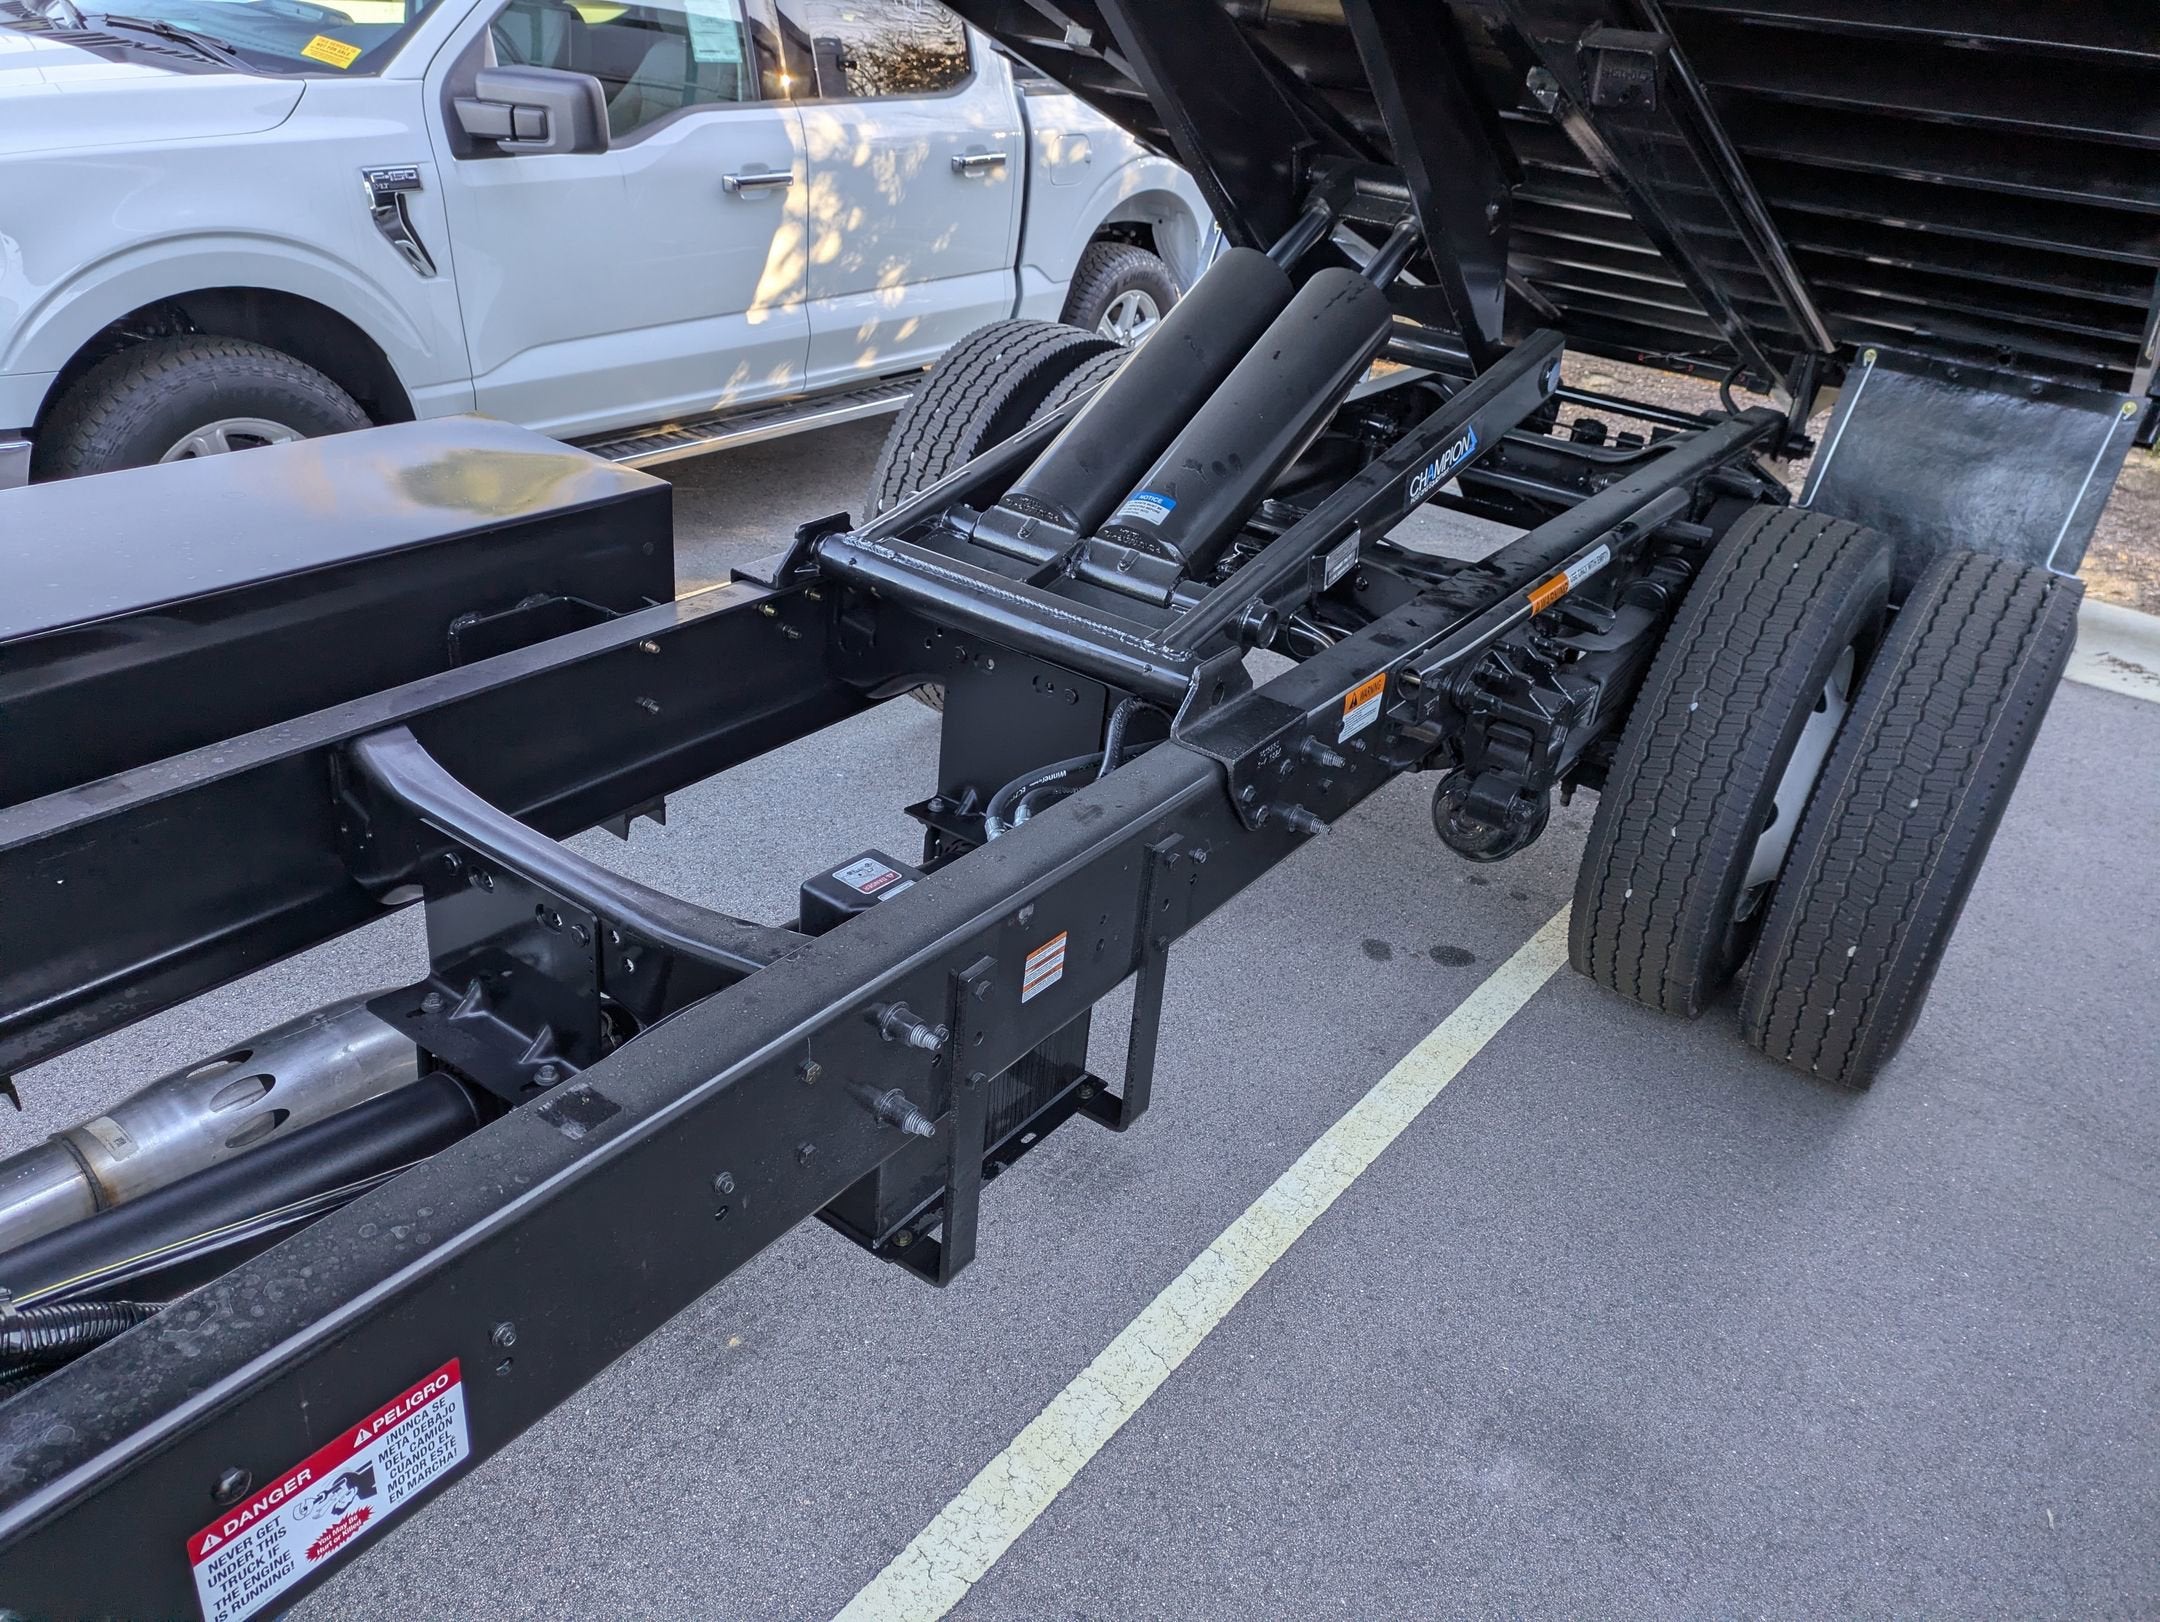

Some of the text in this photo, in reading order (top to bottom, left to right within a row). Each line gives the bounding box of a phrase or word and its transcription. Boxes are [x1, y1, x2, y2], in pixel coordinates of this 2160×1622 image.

[371, 169, 417, 183] F-150
[1410, 432, 1471, 497] CHAMPION
[1139, 494, 1164, 504] NOTICE
[1360, 679, 1382, 701] WARNING
[1042, 769, 1067, 783] Winner
[372, 1374, 449, 1434] PELIGRO
[432, 1397, 446, 1413] SE
[378, 1402, 456, 1463] META DEBAJO
[384, 1415, 453, 1471] DEL CAMIÓN
[389, 1432, 452, 1479] CUANDO EL
[387, 1458, 427, 1493] MOTOR
[430, 1436, 457, 1462] ESTÉ
[389, 1487, 404, 1504] EN
[407, 1448, 458, 1491] MARCHA!
[223, 1468, 312, 1537] DANGER
[318, 1514, 358, 1546] You May Be
[207, 1526, 287, 1588] UNDER THIS
[208, 1515, 281, 1574] NEVER GET
[316, 1519, 362, 1556] Hurt or Killed
[213, 1588, 240, 1611] THE
[243, 1549, 292, 1591] ENGINE
[214, 1611, 228, 1622] IS
[231, 1560, 295, 1613] RUNNING!
[219, 1544, 280, 1593] TRUCK IF
